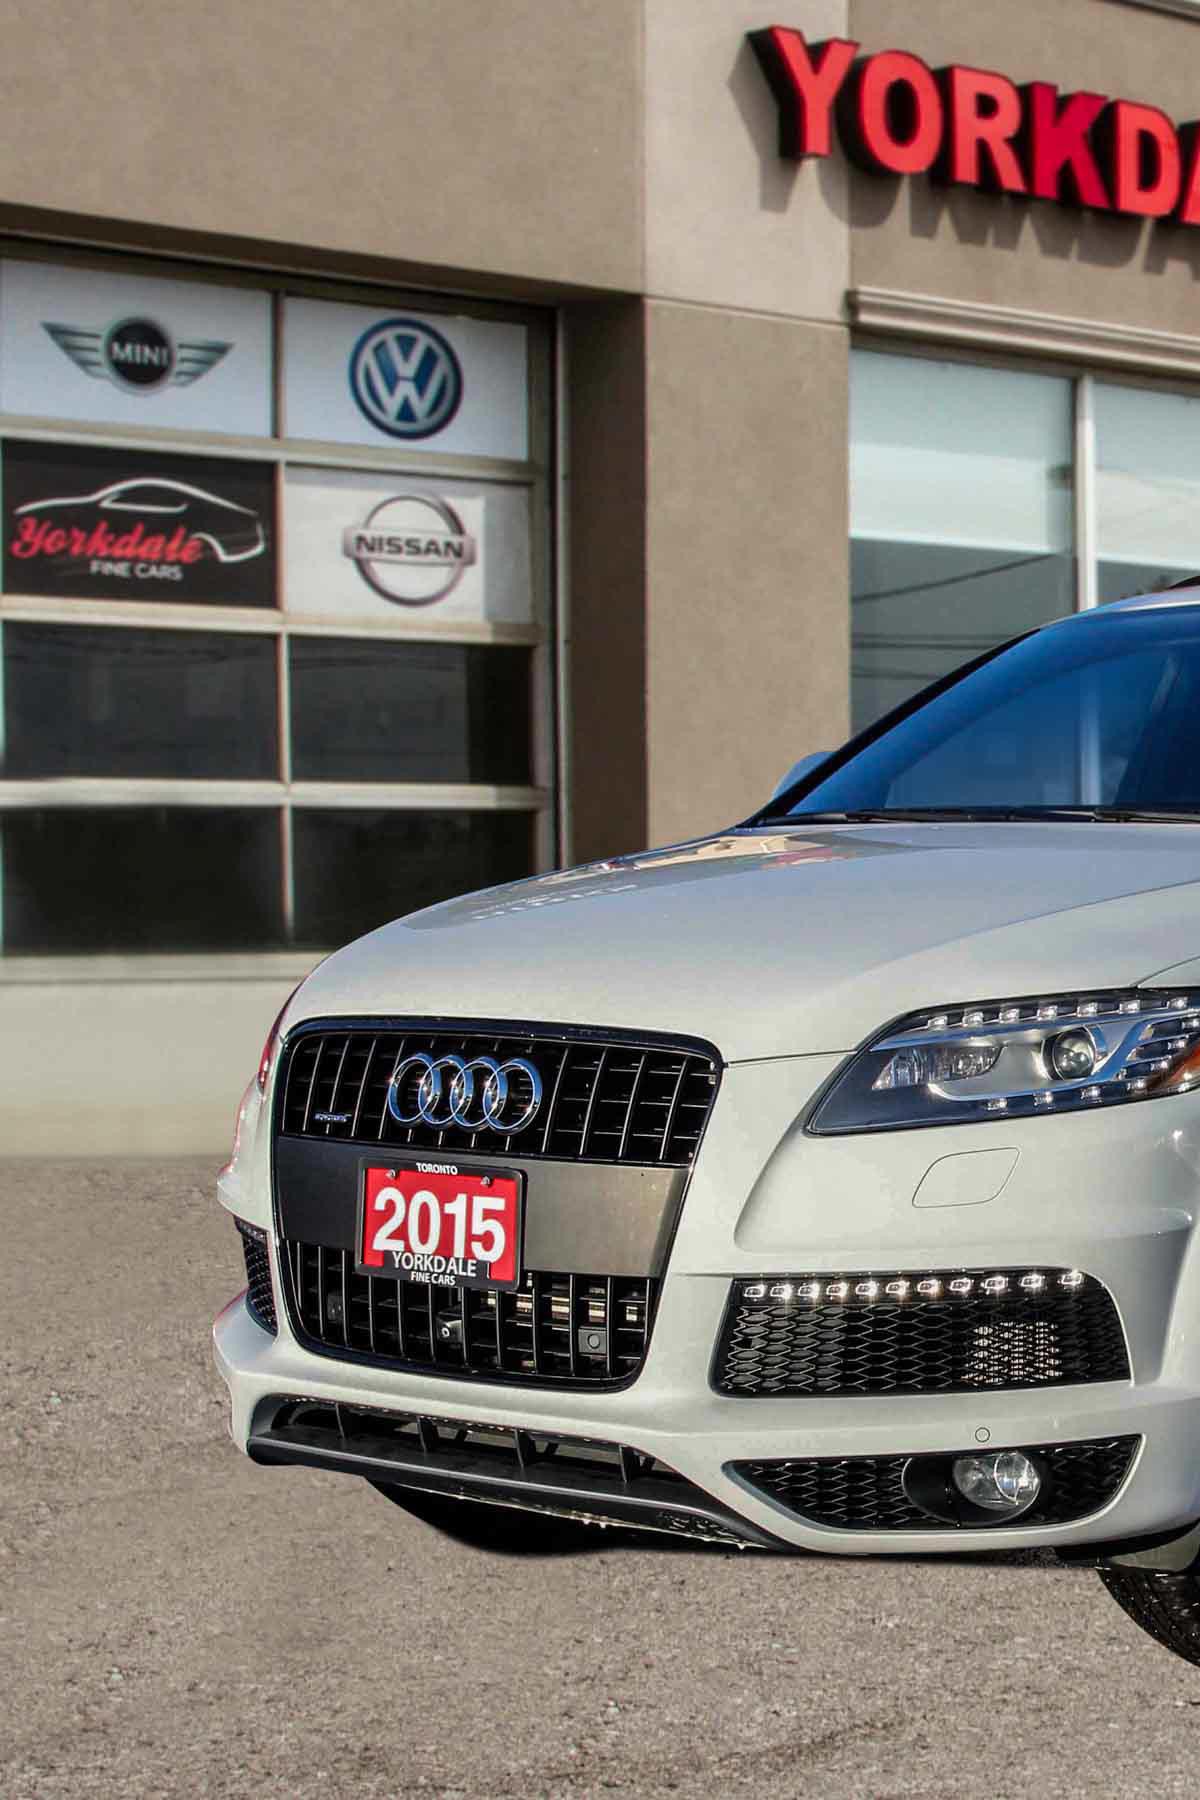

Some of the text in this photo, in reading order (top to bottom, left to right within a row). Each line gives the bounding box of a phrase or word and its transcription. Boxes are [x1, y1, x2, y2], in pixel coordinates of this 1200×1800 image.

[110, 339, 170, 368] MINI
[10, 516, 203, 565] Yorkdale
[353, 534, 466, 560] NISSAN
[89, 560, 183, 581] FINE CARS
[415, 1162, 458, 1176] TORONTO
[372, 1186, 506, 1264] 2015
[392, 1251, 477, 1277] YORKDALE
[410, 1271, 456, 1286] FINE CARS
